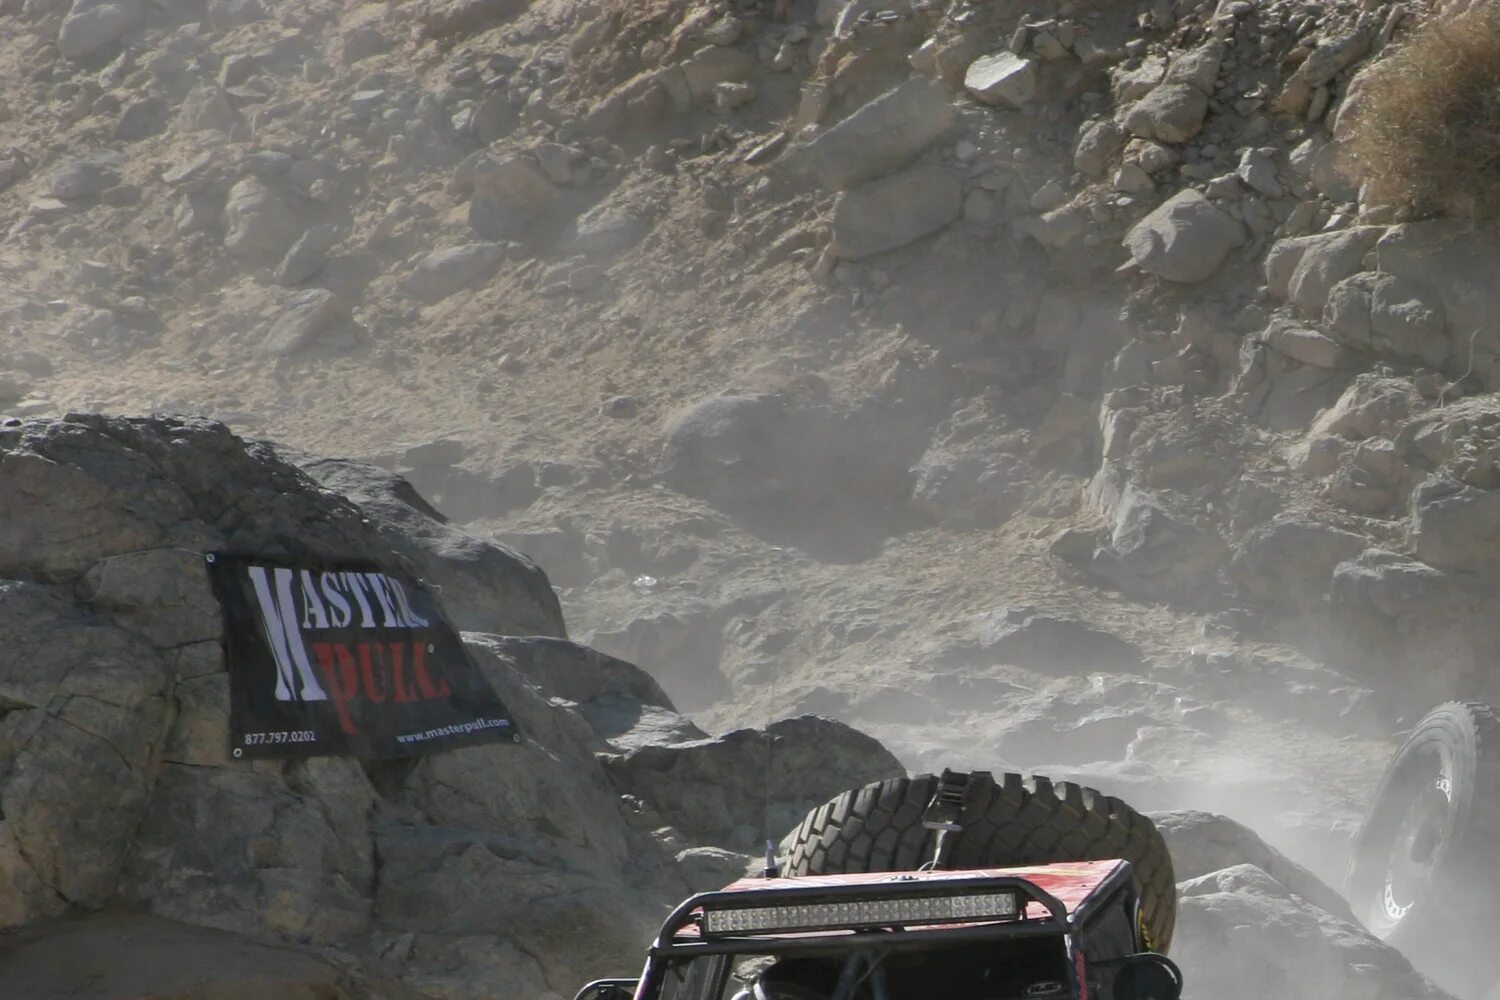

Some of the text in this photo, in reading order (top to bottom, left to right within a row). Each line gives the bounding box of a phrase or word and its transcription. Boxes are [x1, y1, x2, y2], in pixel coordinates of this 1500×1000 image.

[248, 566, 430, 701] MASTER
[313, 642, 452, 735] PULL
[245, 730, 316, 744] 877.797.0202
[396, 718, 510, 743] www.masterpull.com
